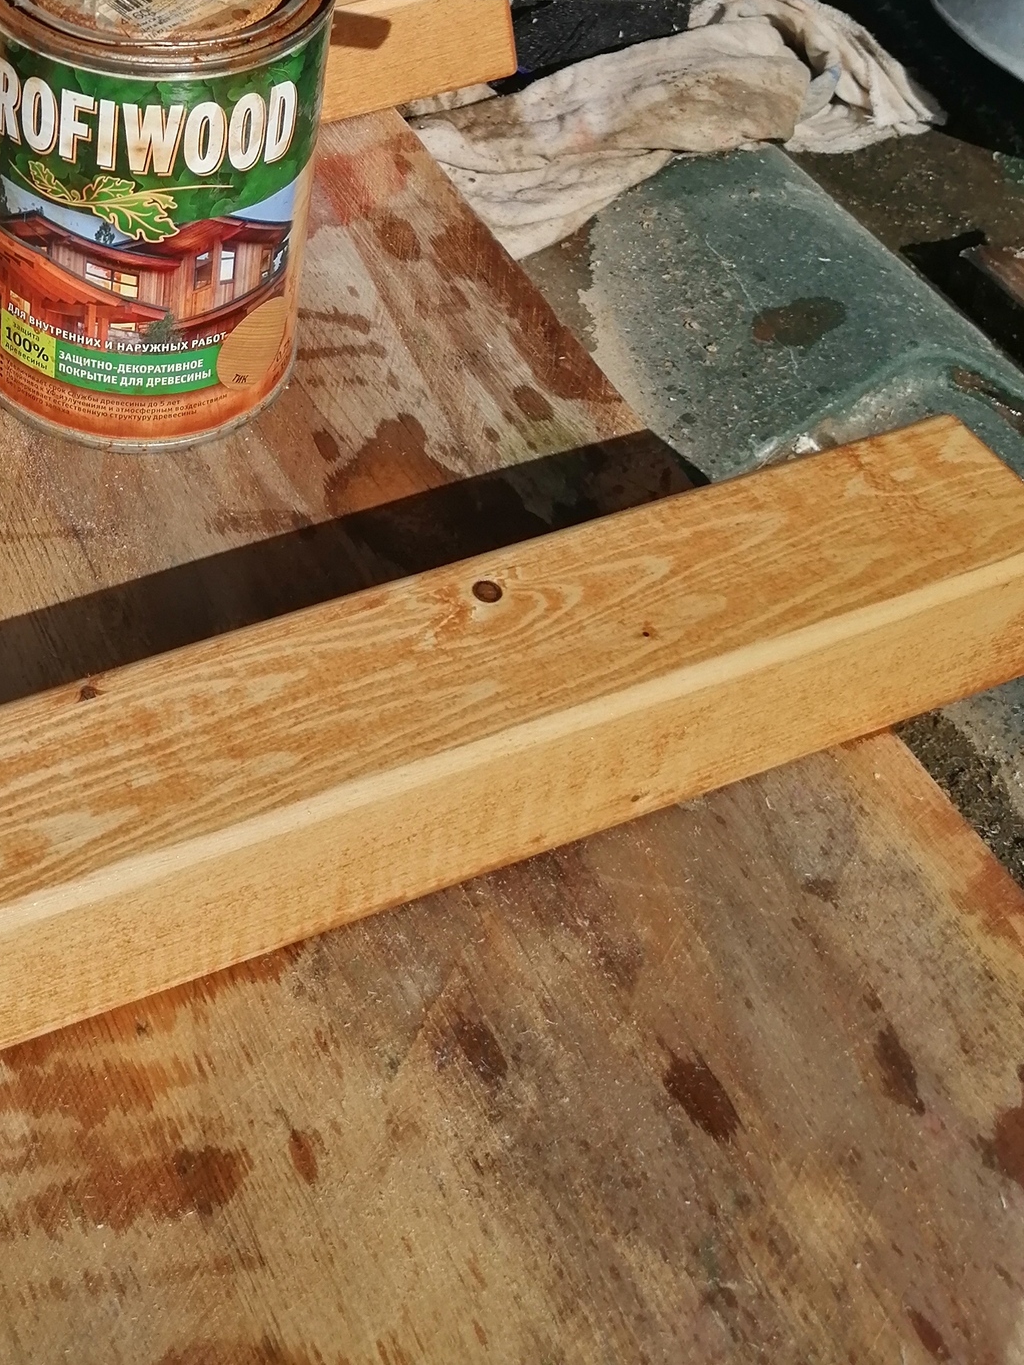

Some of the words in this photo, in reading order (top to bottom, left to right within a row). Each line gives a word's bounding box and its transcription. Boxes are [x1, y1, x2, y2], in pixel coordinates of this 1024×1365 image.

[8, 302, 26, 320] ДЛЯ
[29, 315, 101, 348] ВНУТРЕННИХ
[104, 341, 113, 350] И
[117, 341, 189, 353] НАРУЖНЫХ
[191, 331, 227, 348] РАБОТ
[12, 321, 40, 341] защита
[4, 342, 48, 370] древесины
[5, 326, 49, 362] 100%
[58, 350, 204, 374] ЗАЩИТНО-ДЕКОРАТИВНОЕ
[58, 362, 118, 385] ПОКРЫТИЕ
[119, 376, 144, 387] ДЛЯ
[145, 369, 212, 388] ДРЕВЕСИНЫ
[232, 373, 249, 384] ТИК
[52, 398, 108, 418] естественную
[109, 413, 152, 422] структуру
[152, 409, 197, 421] древесины
[99, 398, 146, 407] древесины
[115, 407, 173, 415] атмосферным
[175, 393, 228, 411] воздействиям
